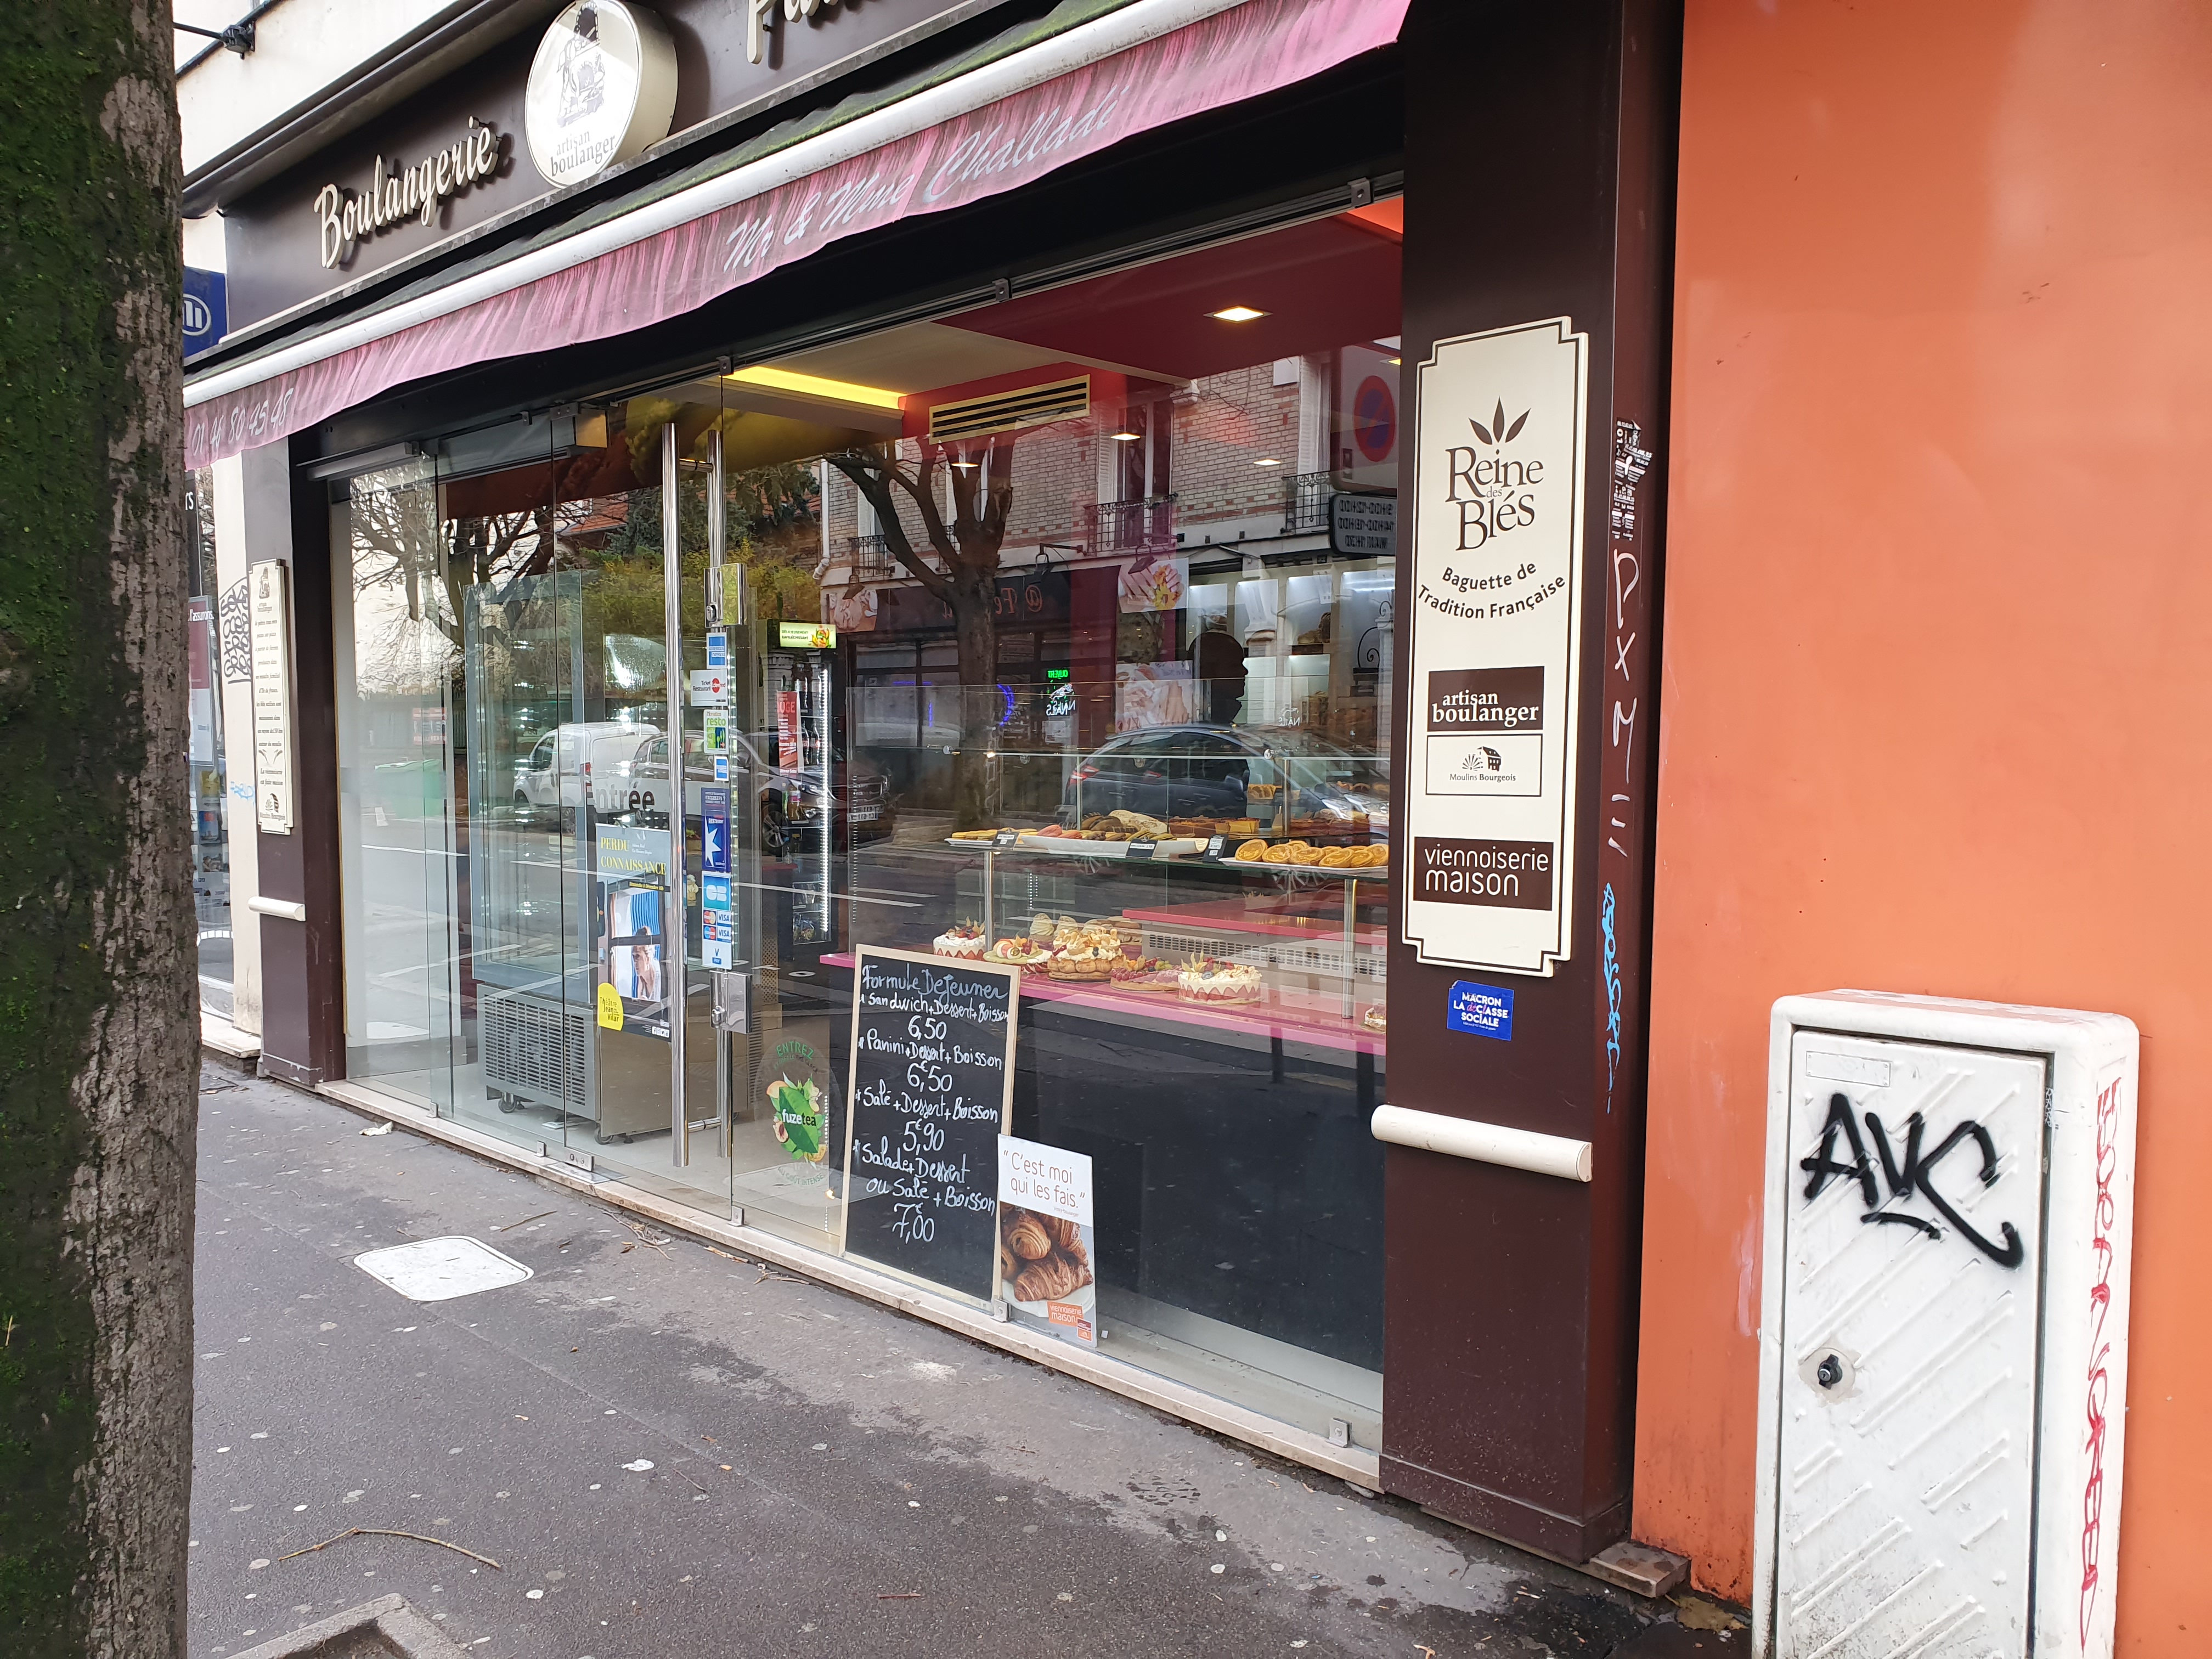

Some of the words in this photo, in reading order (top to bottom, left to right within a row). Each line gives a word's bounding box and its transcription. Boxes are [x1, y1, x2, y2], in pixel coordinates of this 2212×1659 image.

[556, 129, 591, 155] artisan
[550, 134, 617, 177] boulanger
[315, 116, 496, 269] Boulangerie
[724, 222, 775, 272] Mr
[1445, 446, 1544, 502] Reine
[1486, 487, 1502, 498] des
[1455, 490, 1536, 551] Blés
[1442, 567, 1512, 593] Baguette
[1517, 561, 1537, 580] de
[1417, 584, 1484, 619] Tradition
[1489, 575, 1566, 619] Française
[1442, 690, 1498, 707] artisan
[707, 717, 726, 726] resto
[1431, 703, 1539, 727] boulanger
[1449, 772, 1477, 781] Moulins
[1479, 774, 1516, 783] Bourgeois
[588, 781, 654, 811] ntrée
[601, 837, 629, 851] PERDU
[601, 856, 667, 874] CONNAISSANCE
[1425, 843, 1549, 871] viennoiserie
[1425, 869, 1519, 897] maison
[719, 929, 730, 937] VISA
[862, 963, 921, 991] Formule
[1453, 1000, 1465, 1011] LA
[1462, 992, 1502, 1007] MACRON
[1461, 1012, 1499, 1028] SOCIALE
[776, 1041, 814, 1060] ENTREZ
[1049, 1167, 1073, 1184] moi
[1011, 1177, 1028, 1195] qui
[1034, 1179, 1050, 1200] les
[1050, 1305, 1082, 1316] viennoiserie
[1051, 1312, 1076, 1323] maison
